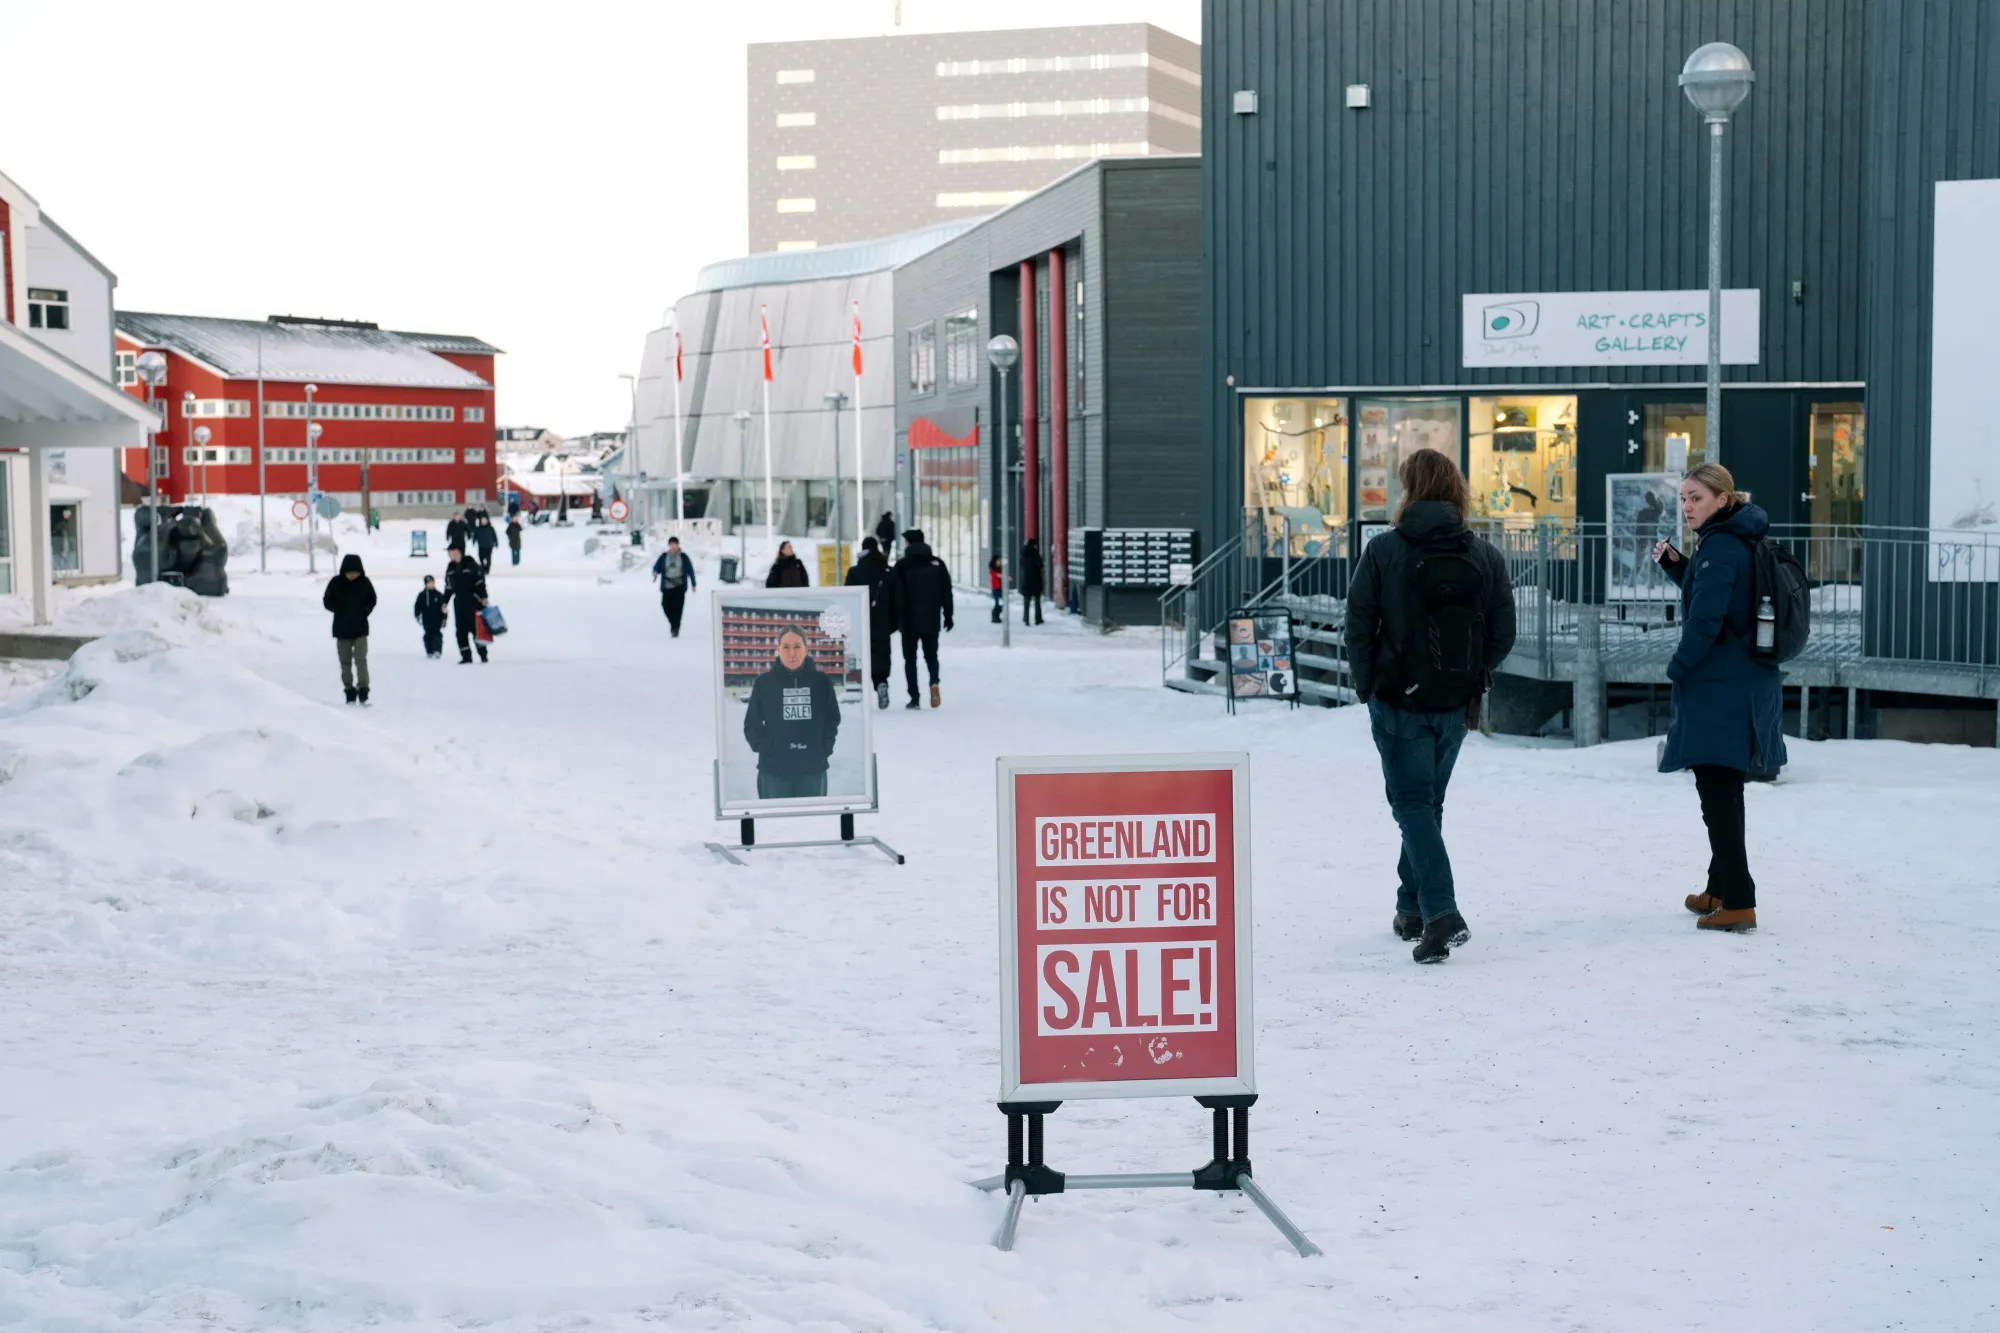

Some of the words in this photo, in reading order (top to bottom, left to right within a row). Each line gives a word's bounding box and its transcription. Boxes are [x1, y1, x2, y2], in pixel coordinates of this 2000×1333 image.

[1576, 314, 1615, 329] ART
[1629, 312, 1707, 329] CRAFTS
[1594, 336, 1688, 352] GALLERY
[784, 706, 811, 719] SALE!
[1041, 819, 1211, 861] GREENLAND
[1041, 886, 1068, 924] IS
[1084, 884, 1141, 923] NOT
[1157, 883, 1211, 921] FOR
[1043, 947, 1212, 1030] SALE!
